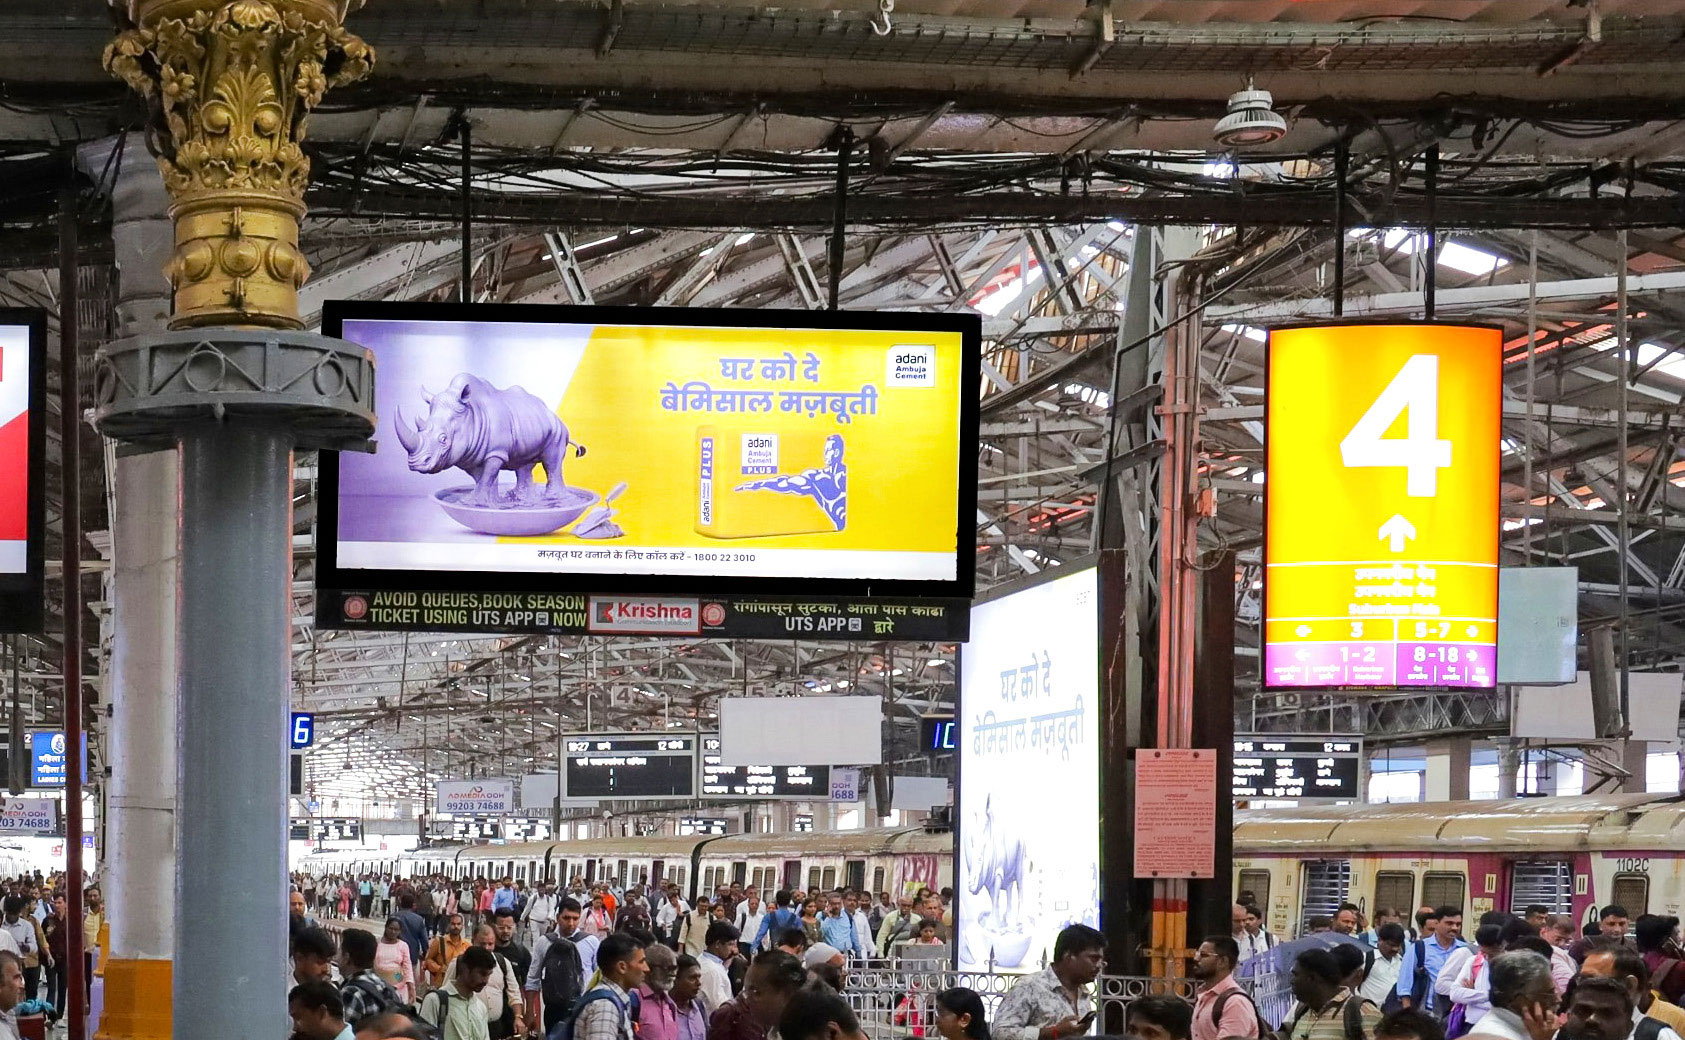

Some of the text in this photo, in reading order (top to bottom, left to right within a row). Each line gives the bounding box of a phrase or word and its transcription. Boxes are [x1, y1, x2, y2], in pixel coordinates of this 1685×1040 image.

[719, 357, 755, 381] घर
[760, 351, 798, 381] को
[895, 352, 928, 365] adani
[895, 365, 928, 374] Ambuja
[895, 372, 927, 380] Cement
[659, 380, 879, 424] बेमिसाल मज़बूती
[1339, 353, 1453, 498] 4
[747, 436, 773, 448] adani
[702, 440, 712, 477] PLUS
[747, 466, 772, 474] PLUS
[694, 553, 718, 562] 1800
[720, 553, 731, 562] 22
[733, 554, 756, 562] 3010
[373, 591, 417, 607] AVOID
[527, 593, 586, 611] SEASON
[370, 608, 588, 628] TICKET USING UTS APP NOW
[617, 601, 692, 620] Krishna
[784, 616, 847, 633] UTS APP
[1350, 621, 1364, 639] 3
[1415, 621, 1451, 639] 5-7
[1000, 668, 1018, 703] घर
[1020, 652, 1039, 700] को
[616, 687, 630, 704] 4
[293, 716, 310, 744] 6
[973, 709, 1027, 758] बेमिसाल
[446, 801, 505, 811] 99203 74688
[18, 818, 50, 828] 74688
[1616, 857, 1650, 872] 1102C
